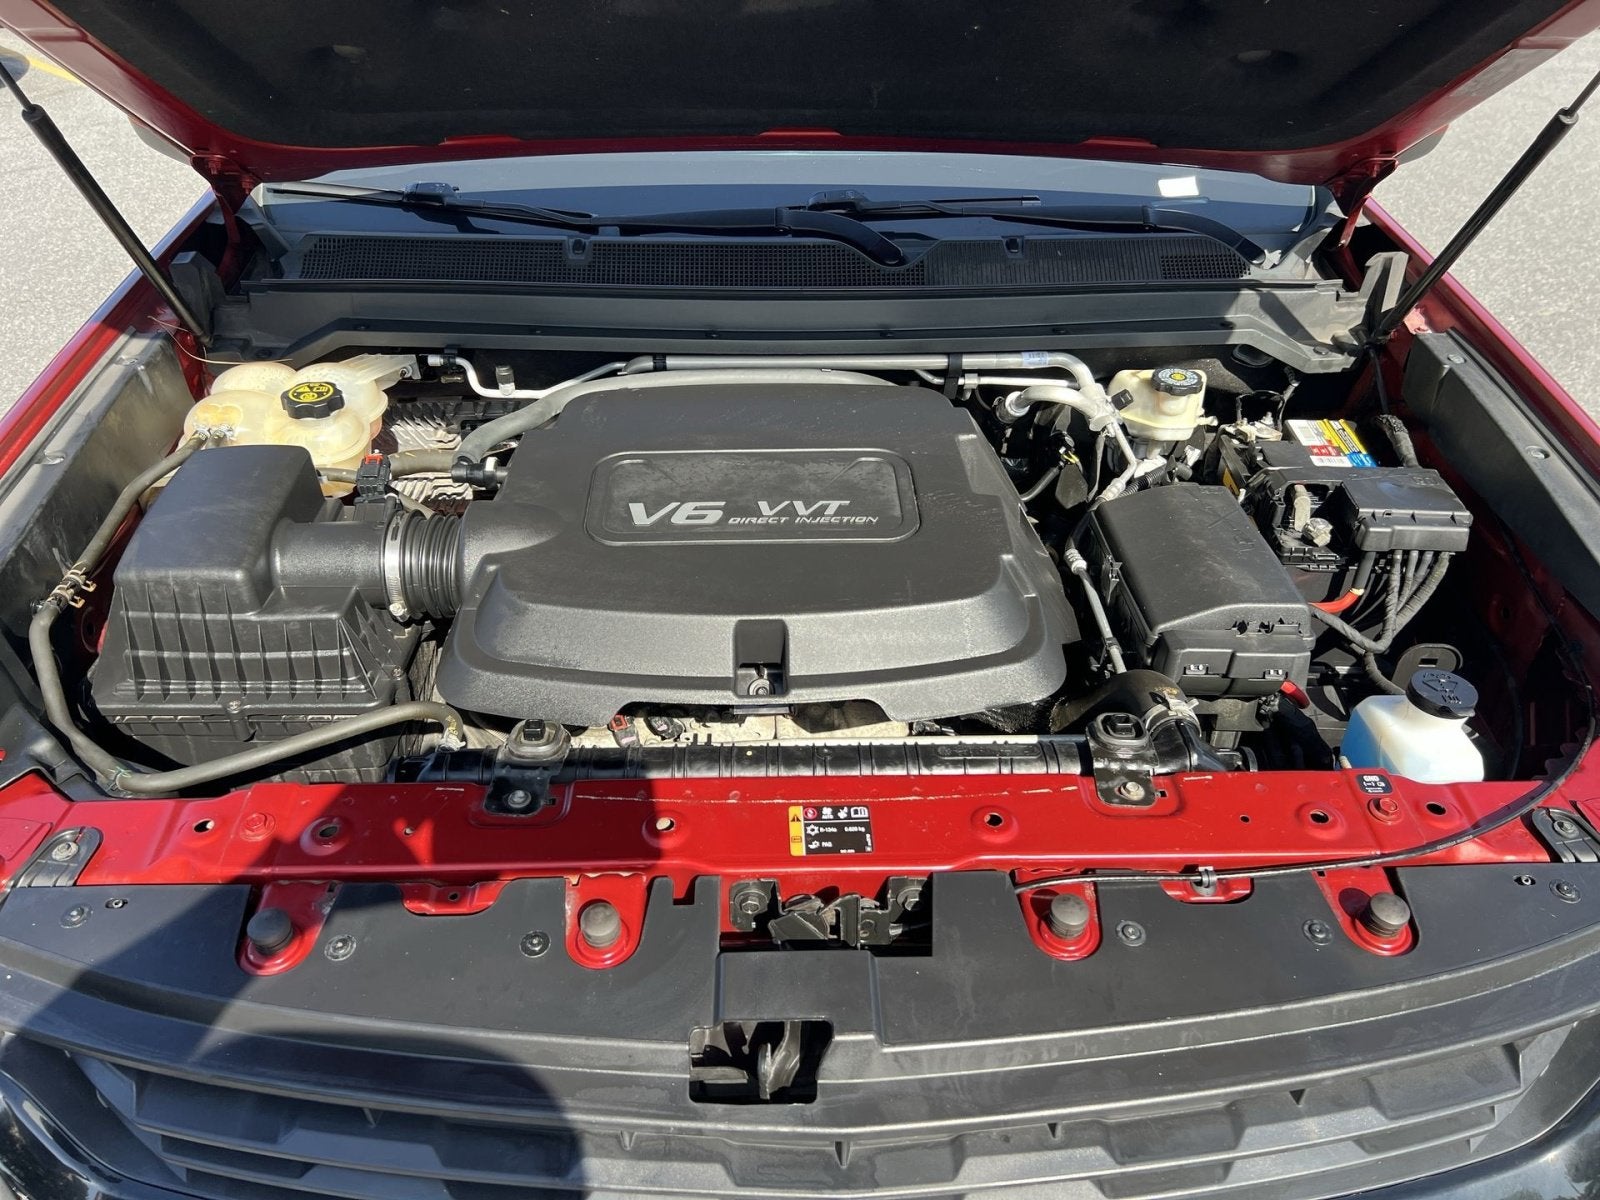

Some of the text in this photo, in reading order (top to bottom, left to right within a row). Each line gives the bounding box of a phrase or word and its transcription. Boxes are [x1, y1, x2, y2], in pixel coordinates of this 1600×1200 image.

[628, 501, 727, 526] V6
[757, 500, 850, 515] VVT
[729, 515, 880, 525] DIRECT INJECTION
